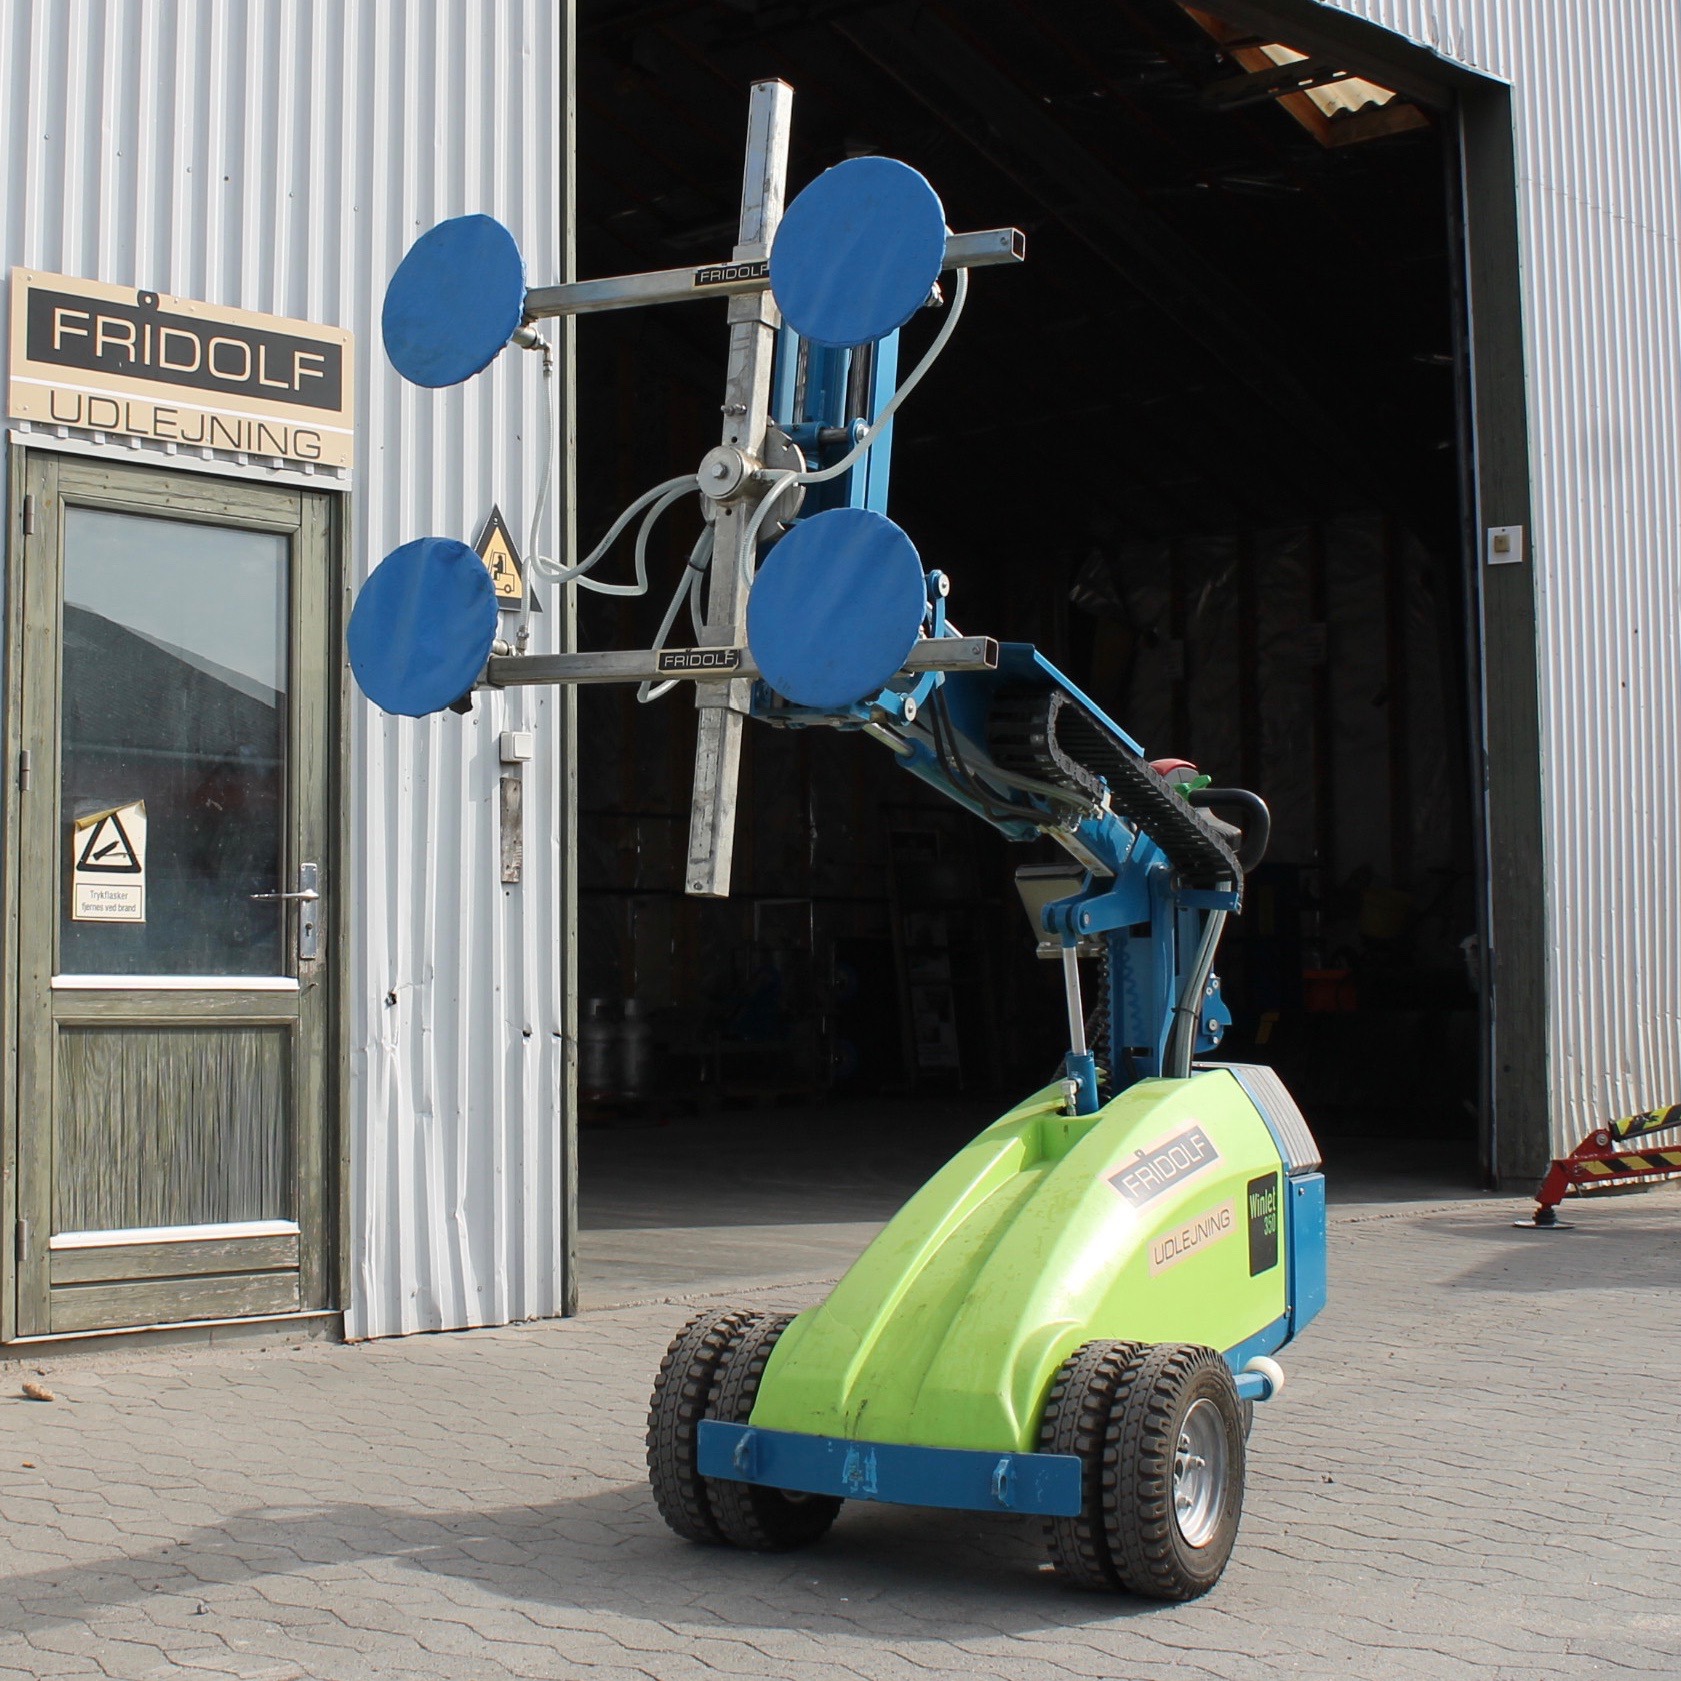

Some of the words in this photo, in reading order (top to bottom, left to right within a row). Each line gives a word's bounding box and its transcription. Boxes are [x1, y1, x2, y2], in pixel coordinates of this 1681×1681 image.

[700, 264, 768, 282] FRIDOLF
[53, 306, 325, 391] FRIDOLF
[50, 390, 322, 460] UDLEJNING
[664, 653, 735, 667] FRIDOLF
[81, 902, 104, 912] fjernes
[105, 904, 117, 912] ved
[117, 904, 136, 912] brand
[90, 890, 128, 901] Trykflasker
[1121, 1134, 1206, 1198] FRIDOLF
[1249, 1186, 1276, 1220] Winlet
[1154, 1208, 1231, 1266] UDLEJNING
